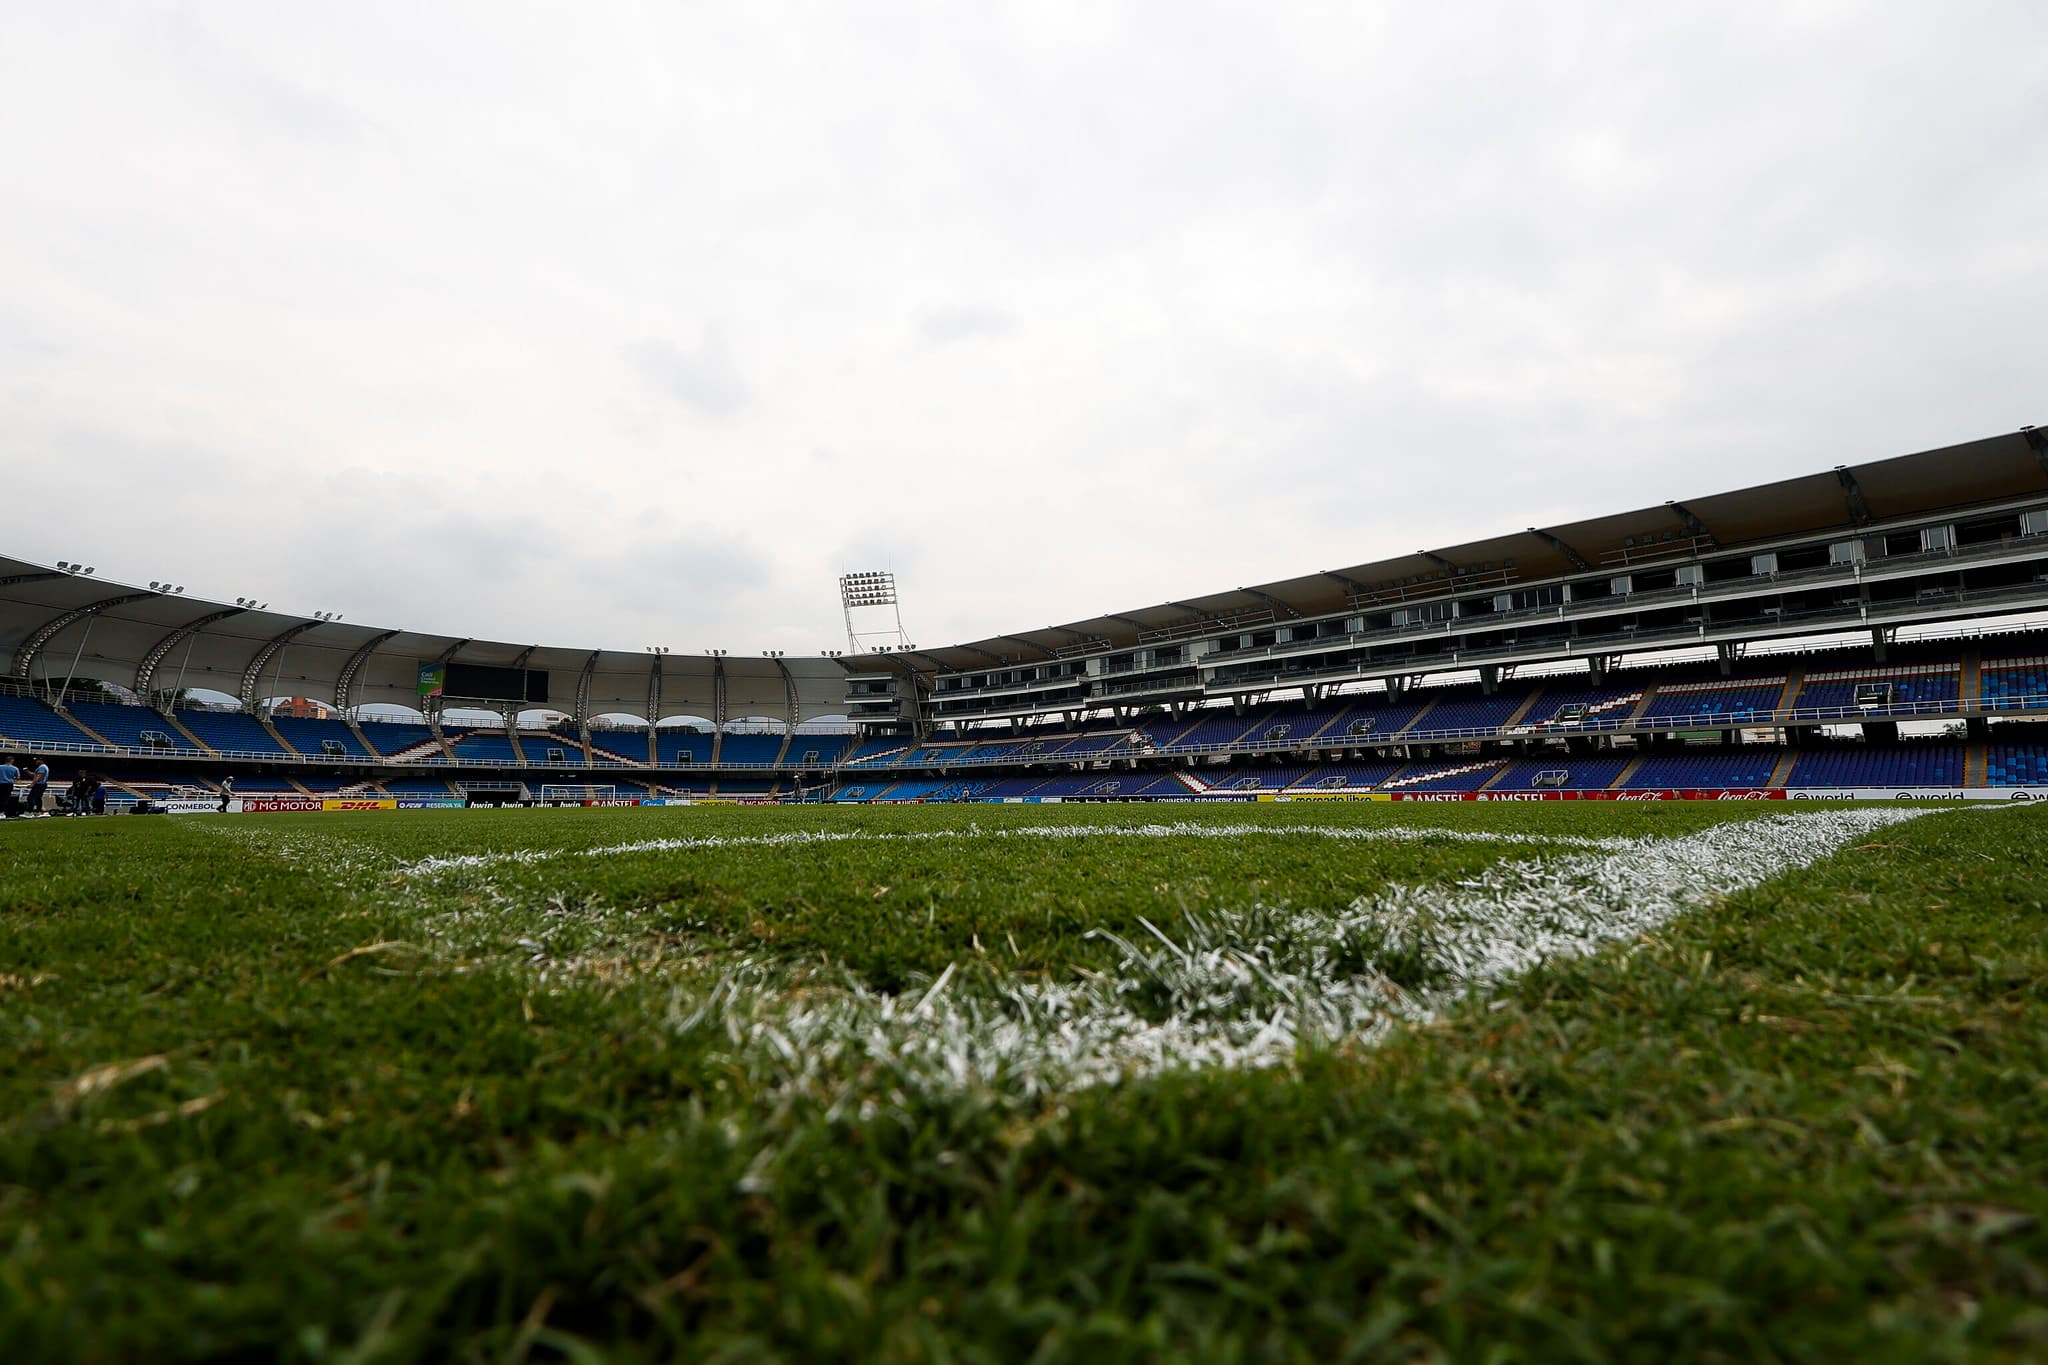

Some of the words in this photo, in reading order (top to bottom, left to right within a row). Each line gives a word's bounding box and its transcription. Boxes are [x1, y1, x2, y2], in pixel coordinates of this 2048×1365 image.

[259, 802, 278, 810] MG
[280, 802, 322, 810] MOTOR
[340, 802, 380, 810] DHL
